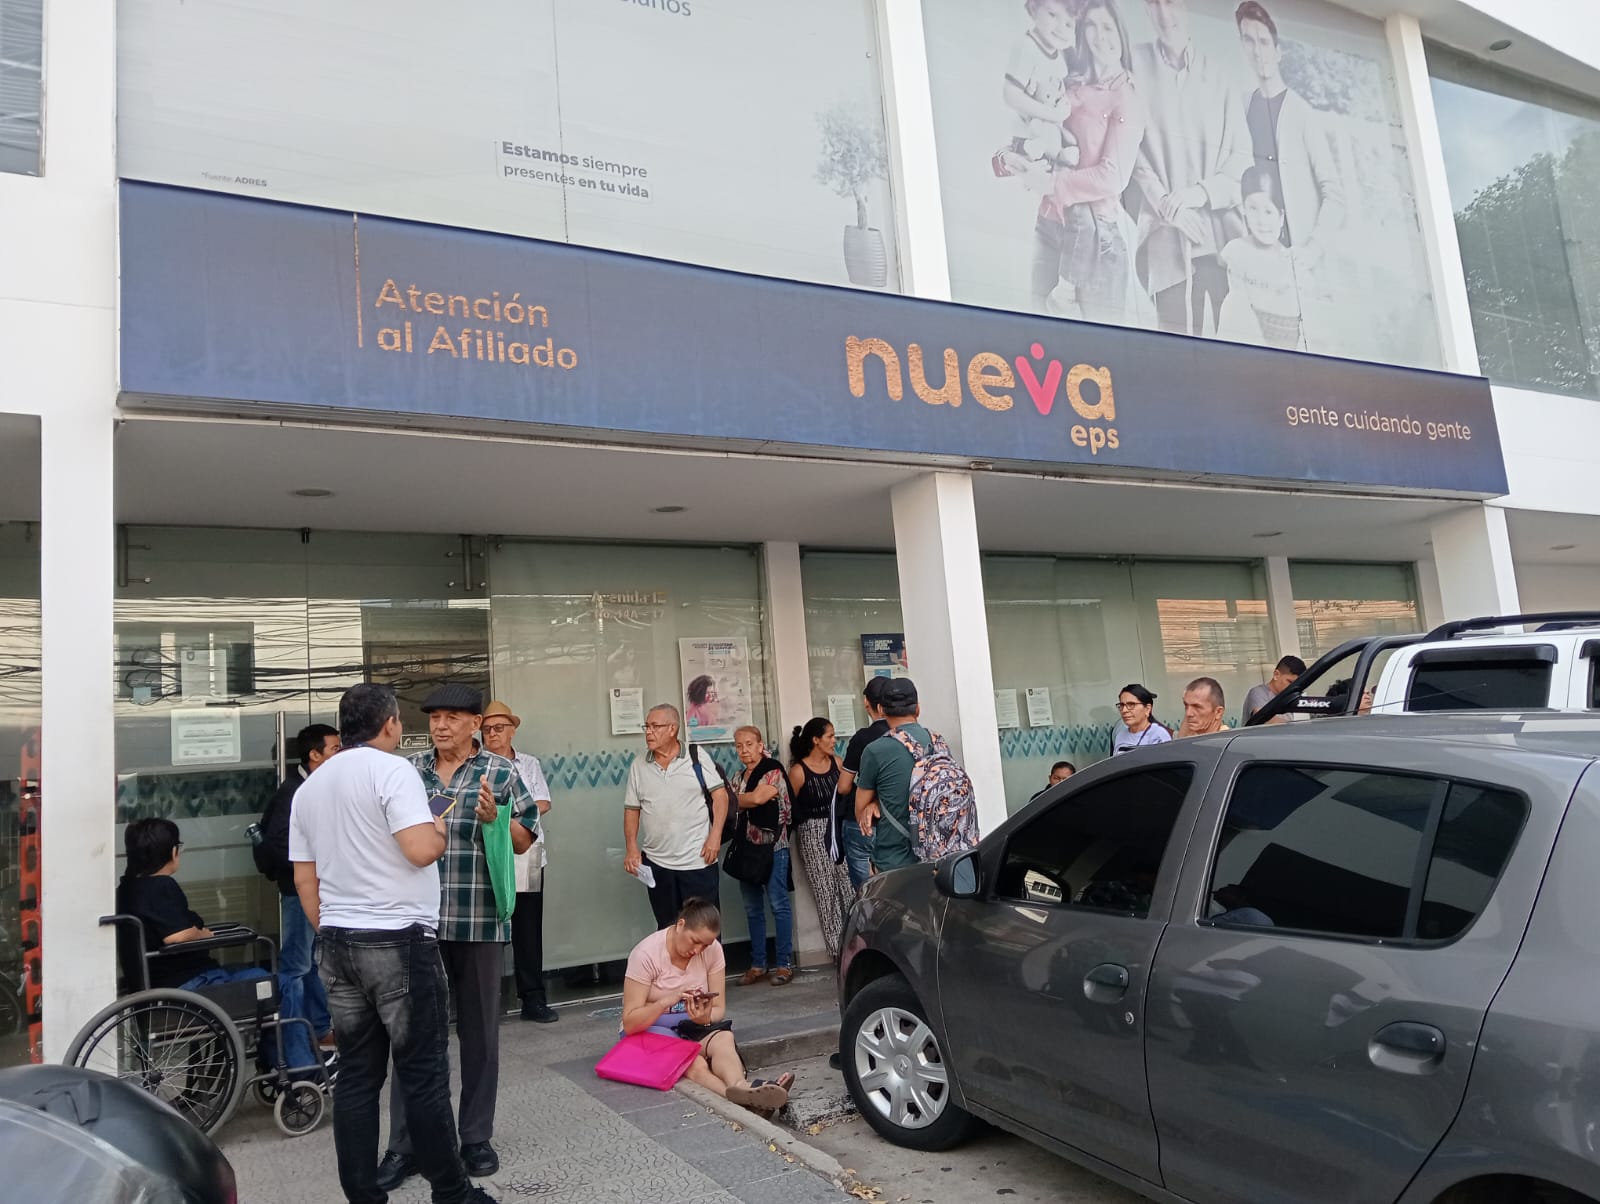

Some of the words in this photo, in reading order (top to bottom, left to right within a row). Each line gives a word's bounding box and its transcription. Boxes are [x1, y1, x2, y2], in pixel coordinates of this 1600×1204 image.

[502, 141, 579, 166] Estamos
[582, 155, 648, 178] siempre
[504, 165, 576, 186] presentes
[578, 177, 597, 190] en
[600, 179, 616, 193] tu
[618, 182, 649, 199] vida
[375, 278, 549, 328] Atención
[377, 320, 413, 353] al
[427, 326, 578, 369] Afiliado
[846, 335, 1116, 422] nueva
[1070, 424, 1120, 456] eps
[1286, 405, 1339, 426] gente
[1344, 410, 1422, 436] cuidando
[1427, 421, 1472, 441] gente
